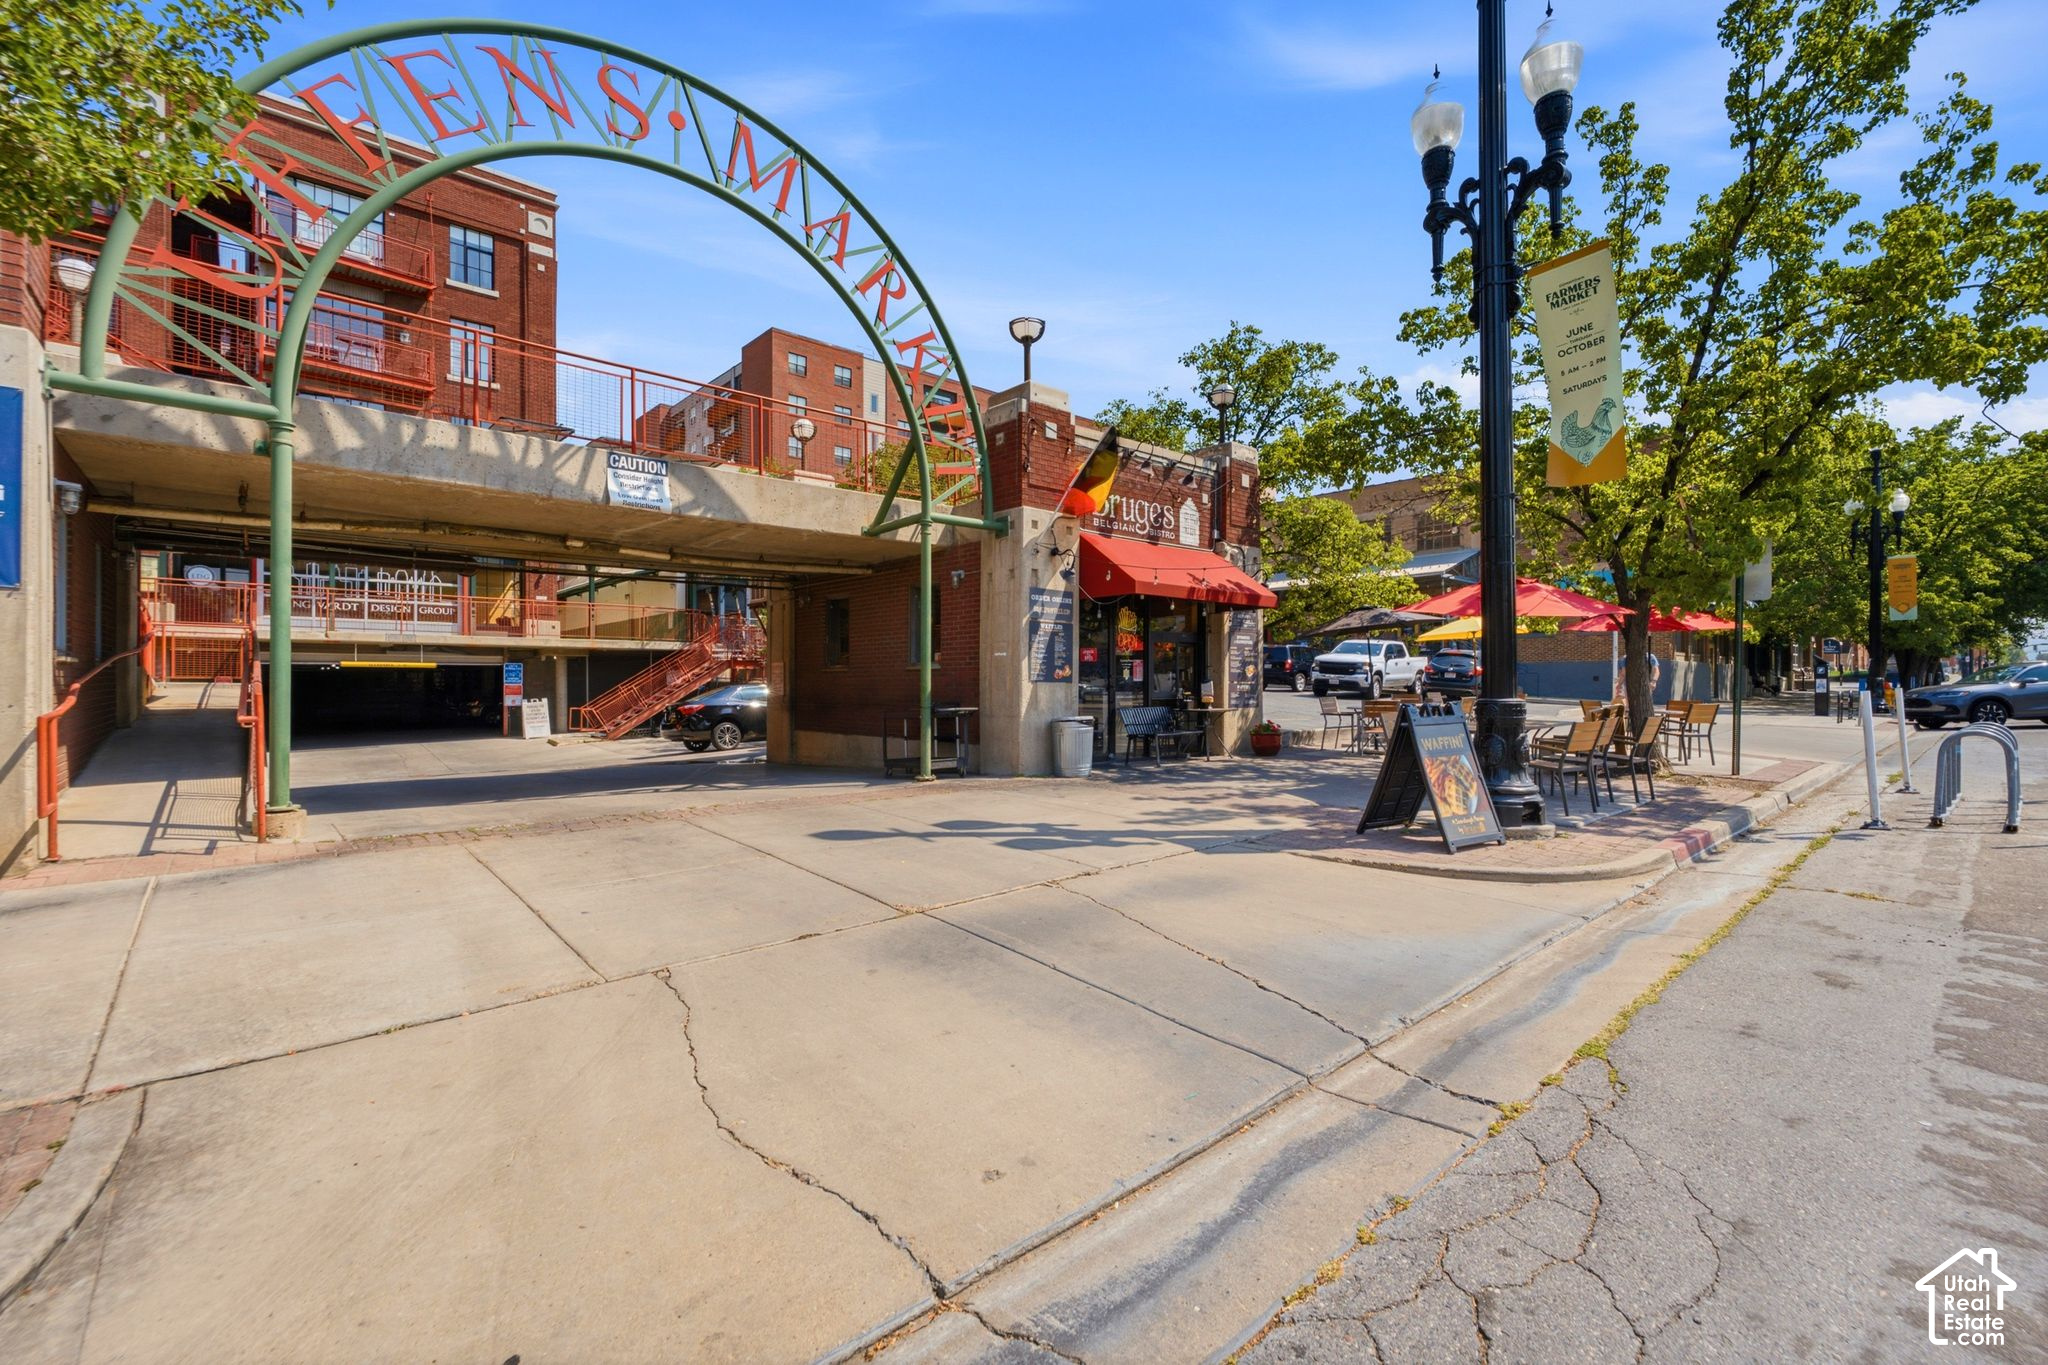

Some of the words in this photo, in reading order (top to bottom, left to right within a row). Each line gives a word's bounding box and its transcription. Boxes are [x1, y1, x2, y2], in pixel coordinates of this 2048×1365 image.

[718, 116, 977, 478] MARKET
[1546, 275, 1600, 302] FARMERS
[1550, 286, 1598, 310] MARKET
[1566, 322, 1594, 338] JUNE
[1558, 336, 1605, 358] OCTOBER
[1568, 366, 1579, 374] AM
[1596, 356, 1606, 364] PM
[1562, 374, 1607, 394] SATURDAYS
[610, 454, 666, 475] CAUTION
[613, 472, 642, 480] Consider
[644, 476, 664, 485] Height
[620, 482, 658, 492] Restrictios
[622, 500, 660, 510] Restrictions
[1093, 518, 1135, 533] BELGIAN
[1150, 528, 1176, 539] BISTRO
[371, 603, 411, 613] DESIGN
